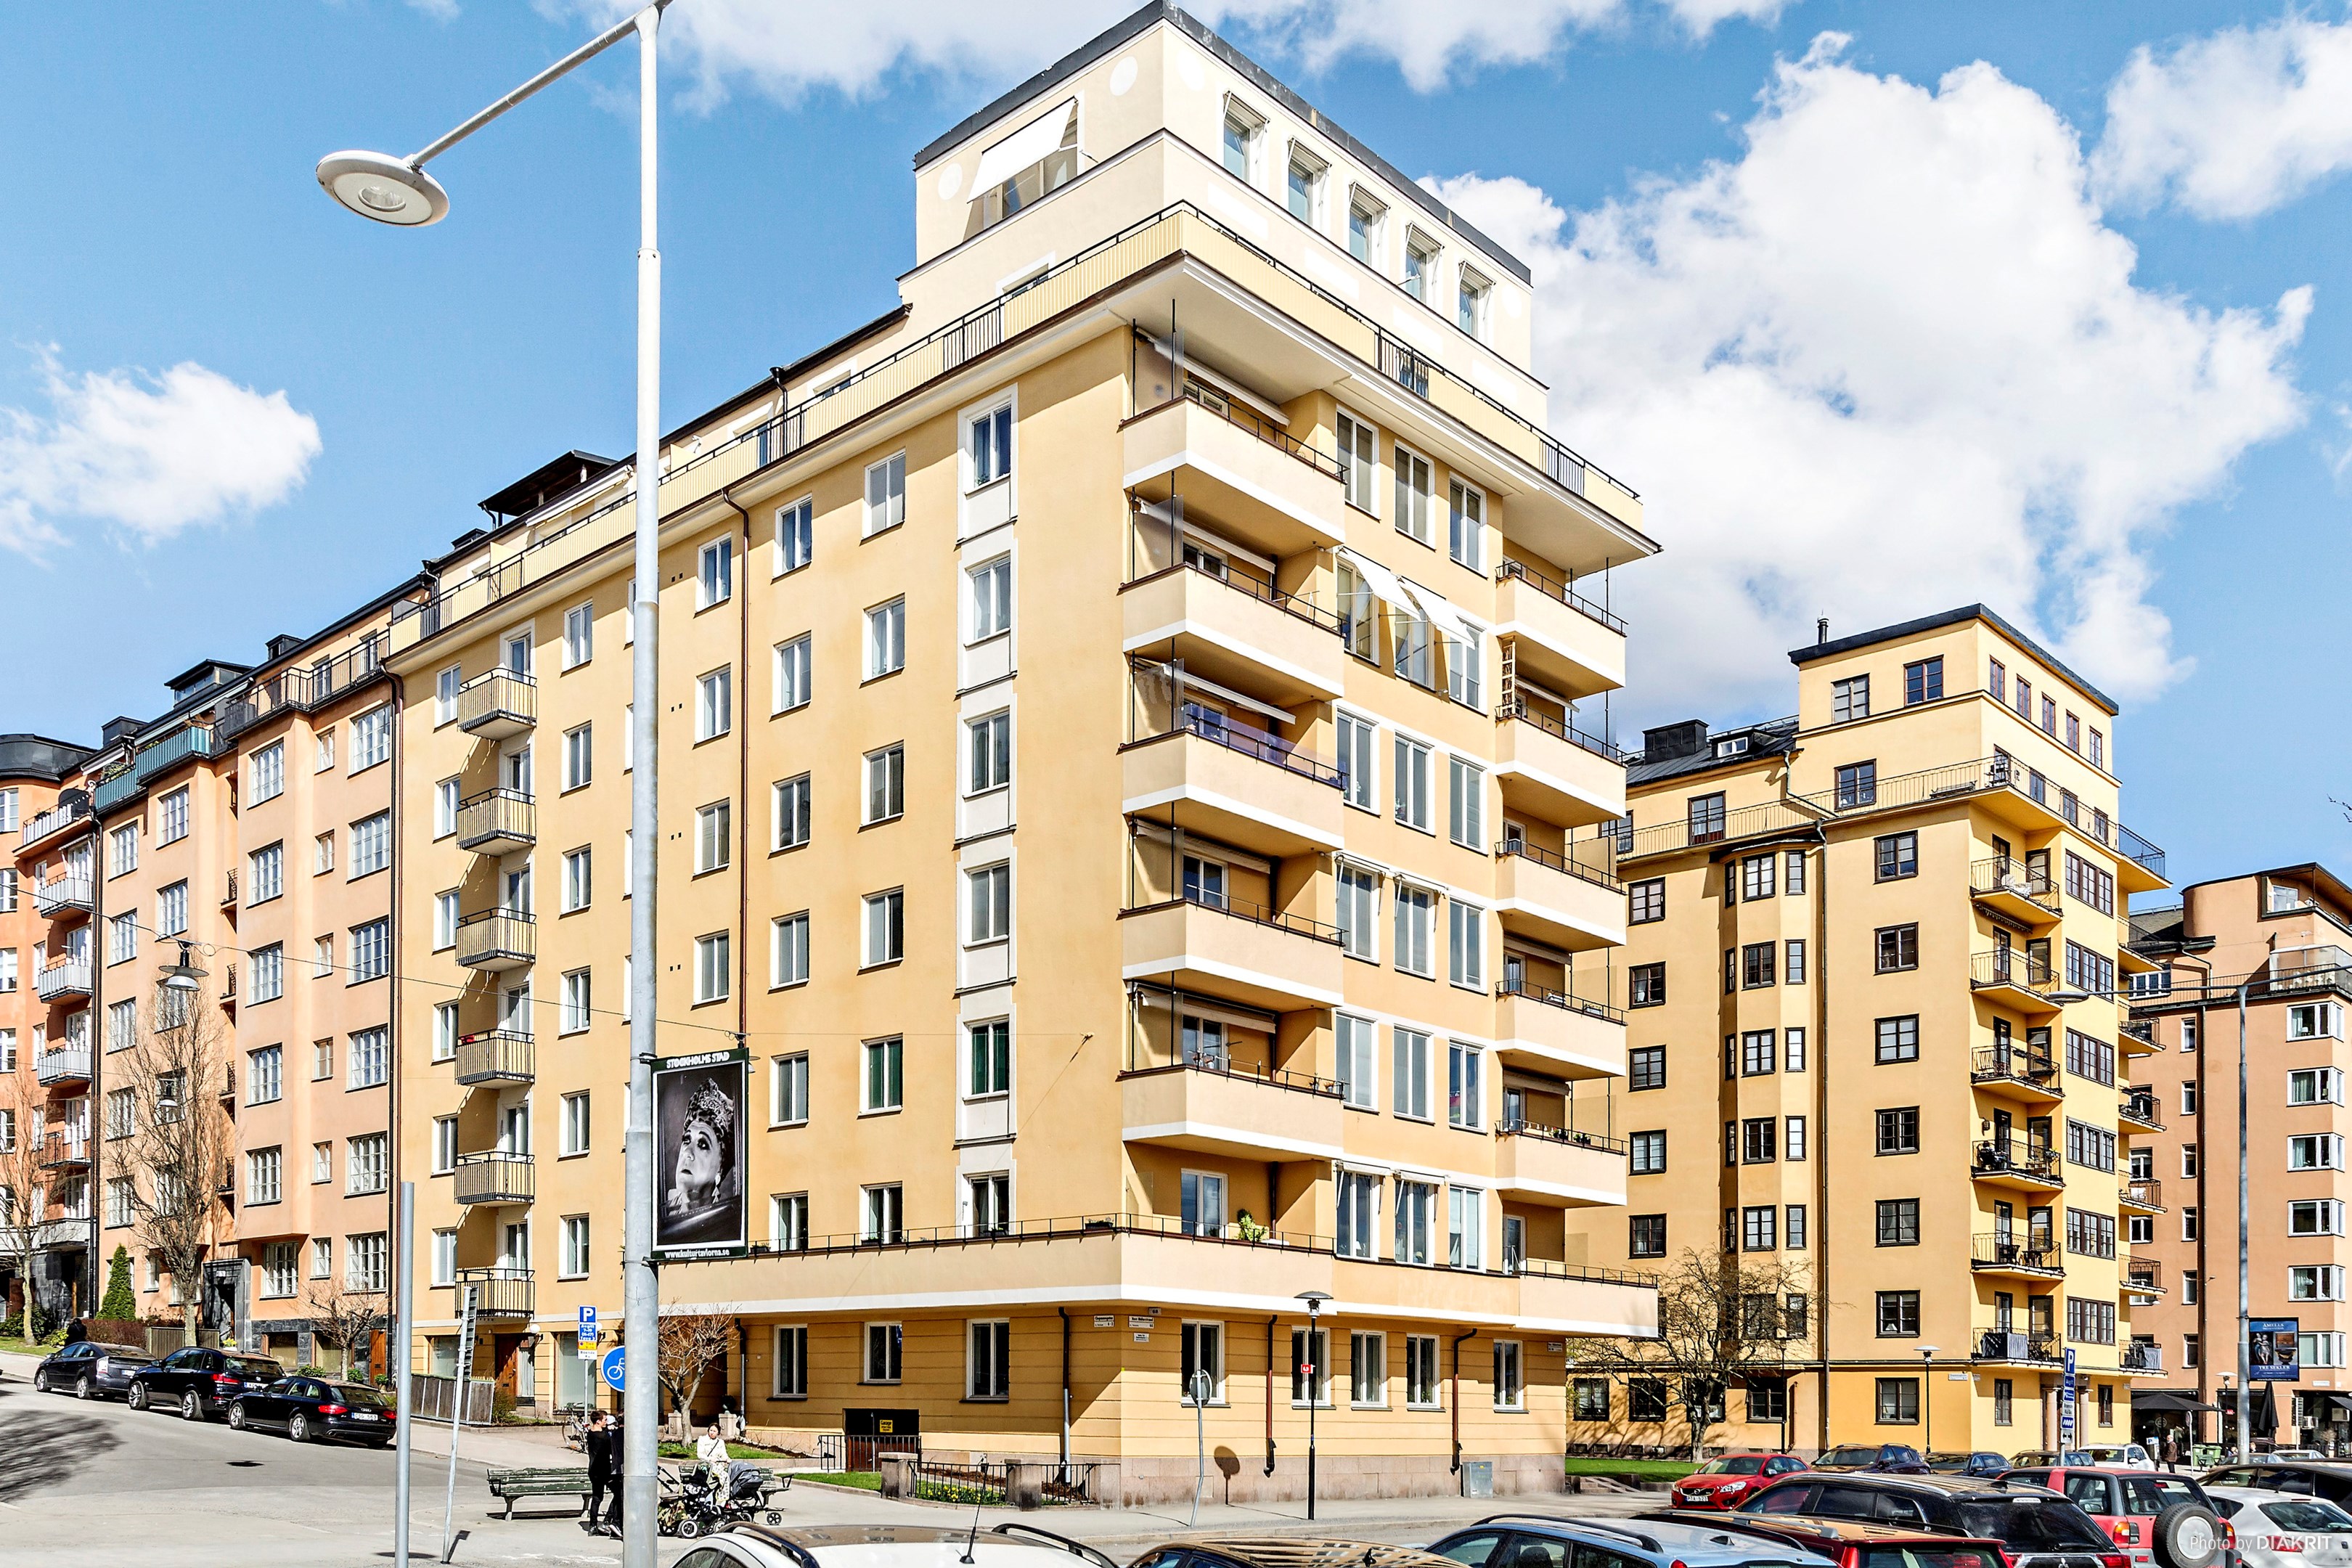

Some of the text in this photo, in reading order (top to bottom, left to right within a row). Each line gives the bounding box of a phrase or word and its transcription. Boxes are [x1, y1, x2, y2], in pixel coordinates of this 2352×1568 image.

[666, 1051, 730, 1069] STOCKHOLMS STAD
[583, 1307, 594, 1322] P
[2067, 1351, 2074, 1371] P
